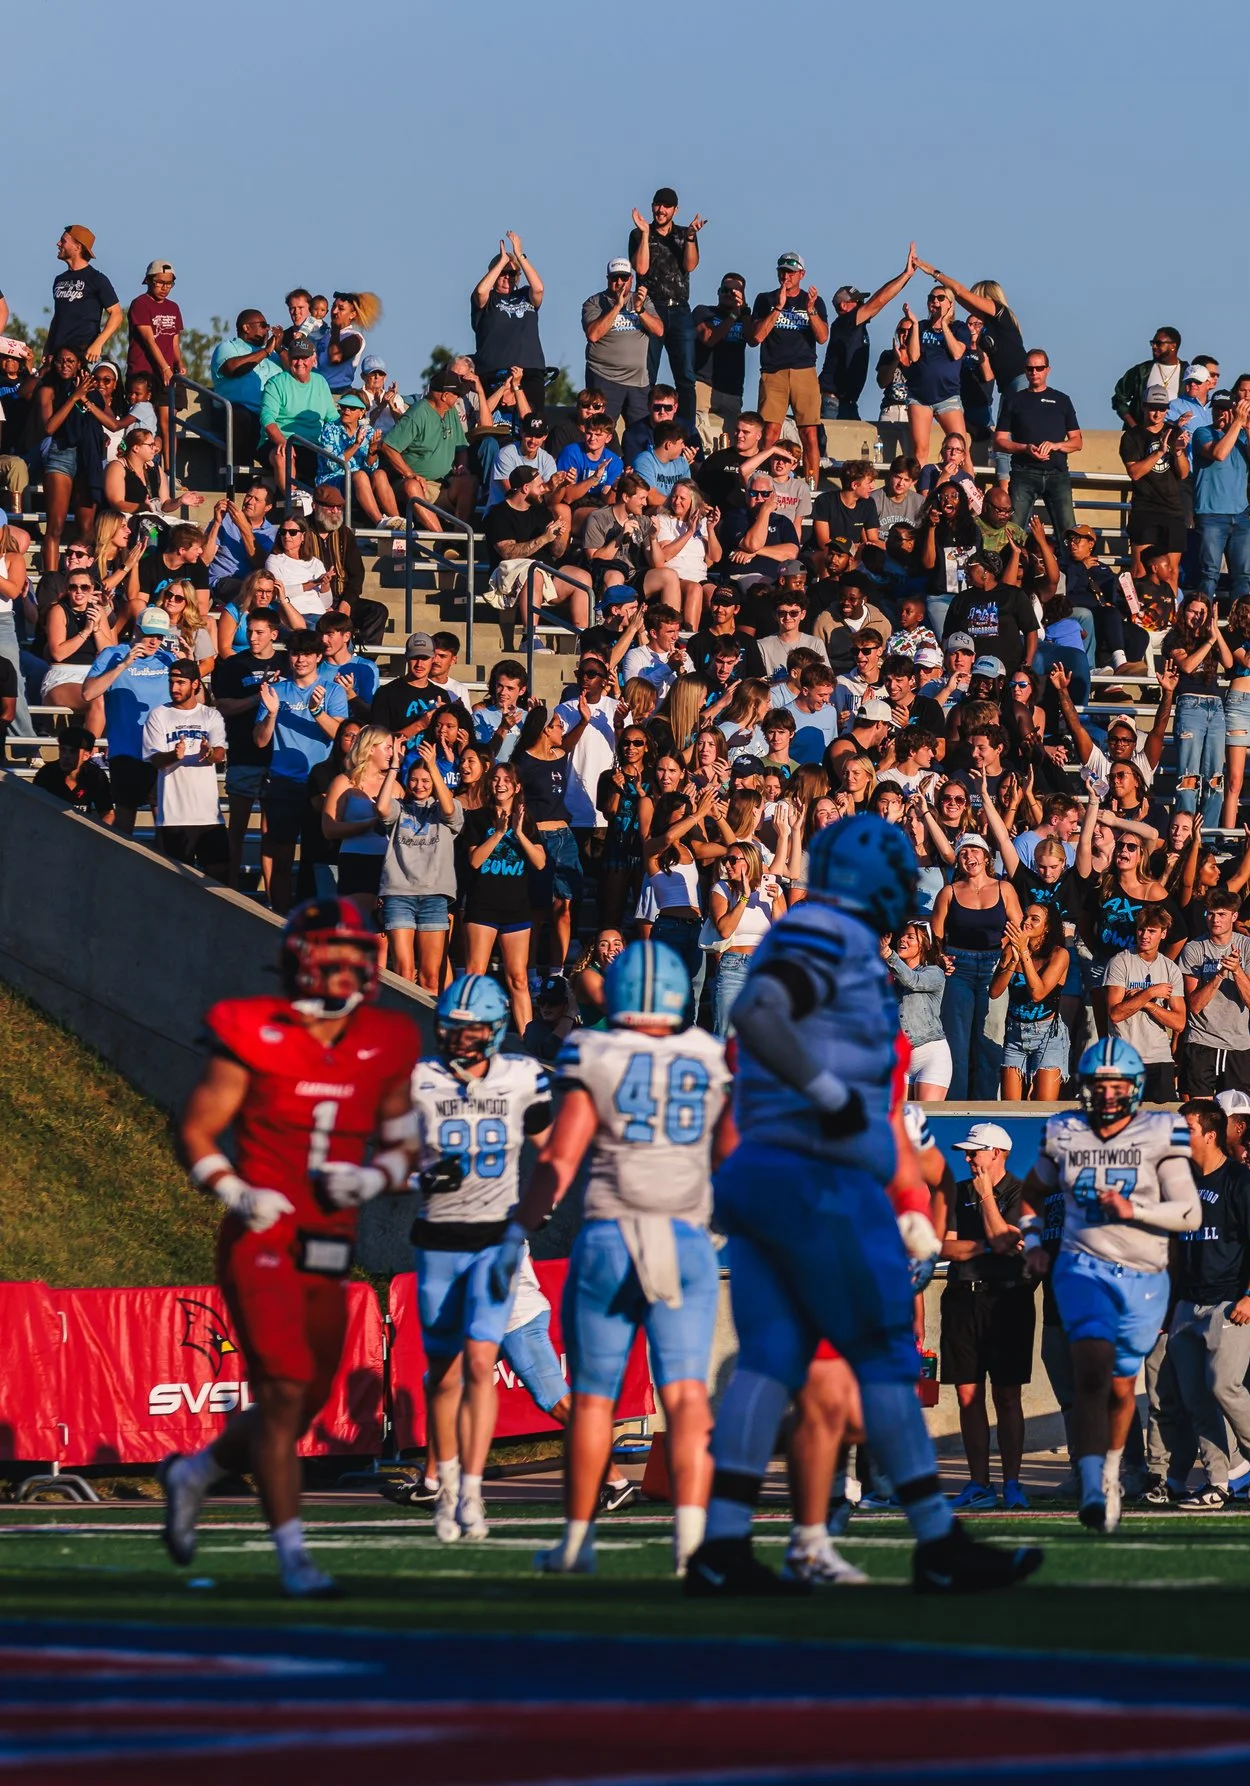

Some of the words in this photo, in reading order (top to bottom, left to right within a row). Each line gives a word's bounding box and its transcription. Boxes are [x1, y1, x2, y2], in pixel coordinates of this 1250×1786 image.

[128, 667, 169, 677] Northwood
[435, 1098, 508, 1118] NORTHWOOD
[614, 1053, 709, 1143] 48
[308, 1100, 339, 1173] 1
[1067, 1148, 1143, 1167] NORTHWOOD
[1071, 1167, 1138, 1222] 47
